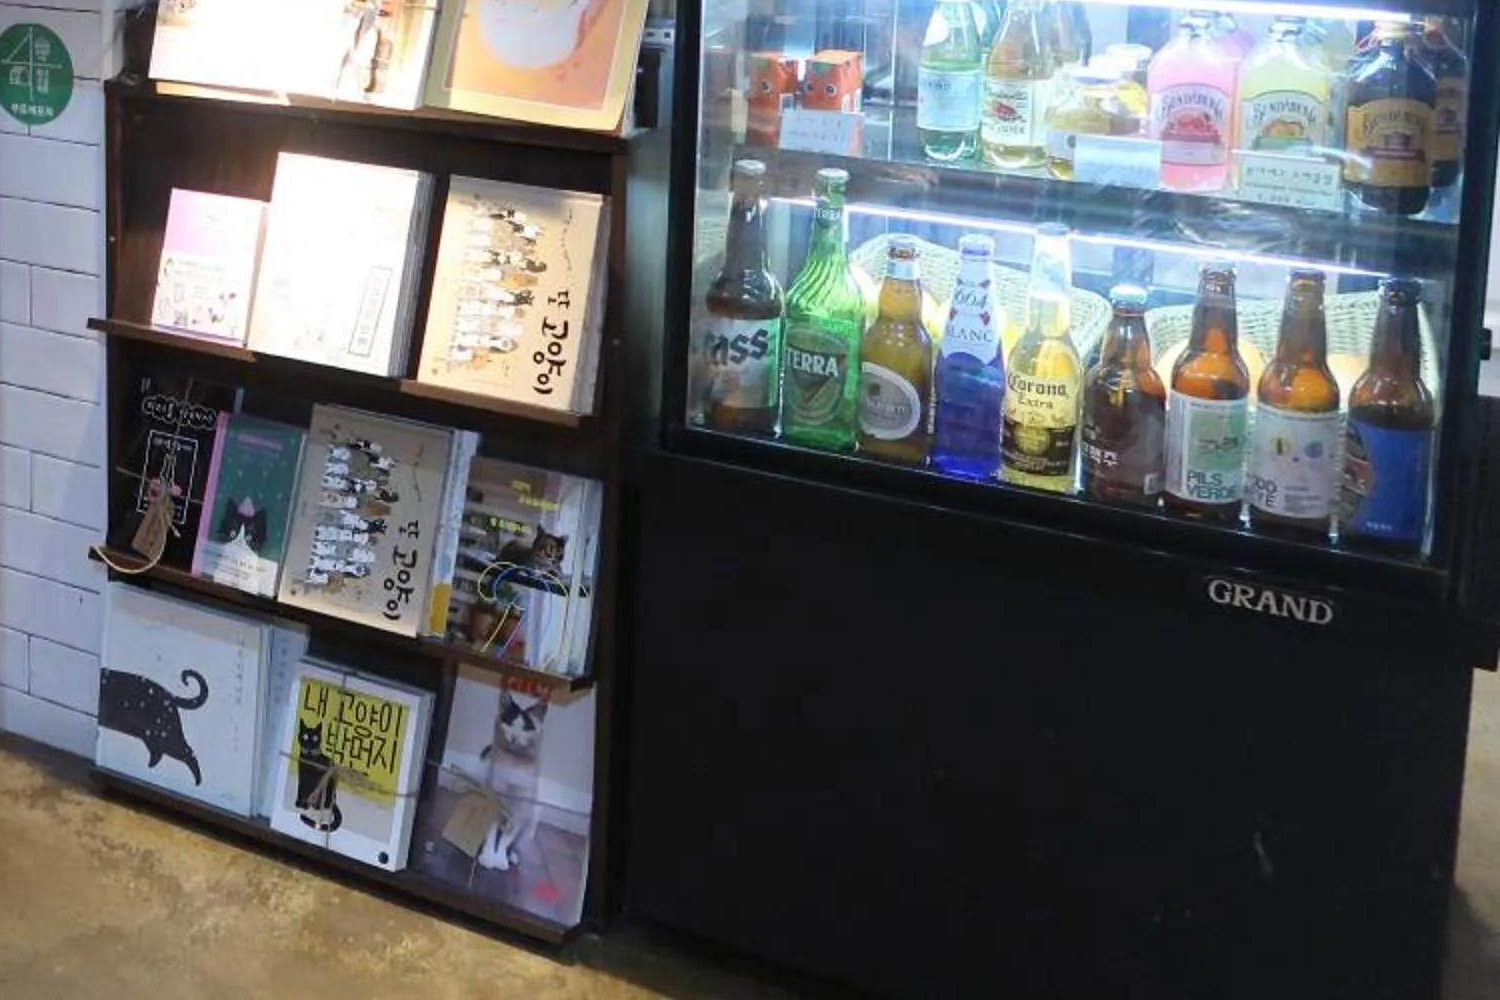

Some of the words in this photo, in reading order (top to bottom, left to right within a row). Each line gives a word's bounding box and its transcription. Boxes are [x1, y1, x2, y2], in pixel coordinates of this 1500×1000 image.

[547, 289, 571, 310] 또
[953, 286, 988, 309] 664
[533, 318, 570, 396] 고양이
[786, 348, 839, 378] TERRA
[1007, 373, 1068, 398] Corona
[1018, 395, 1054, 410] Extra
[1187, 472, 1223, 487] PILS
[398, 519, 419, 539] 또
[382, 545, 418, 622] 고양이
[1208, 578, 1334, 627] GRAND
[303, 683, 329, 719] 내
[334, 690, 403, 739] 고양이
